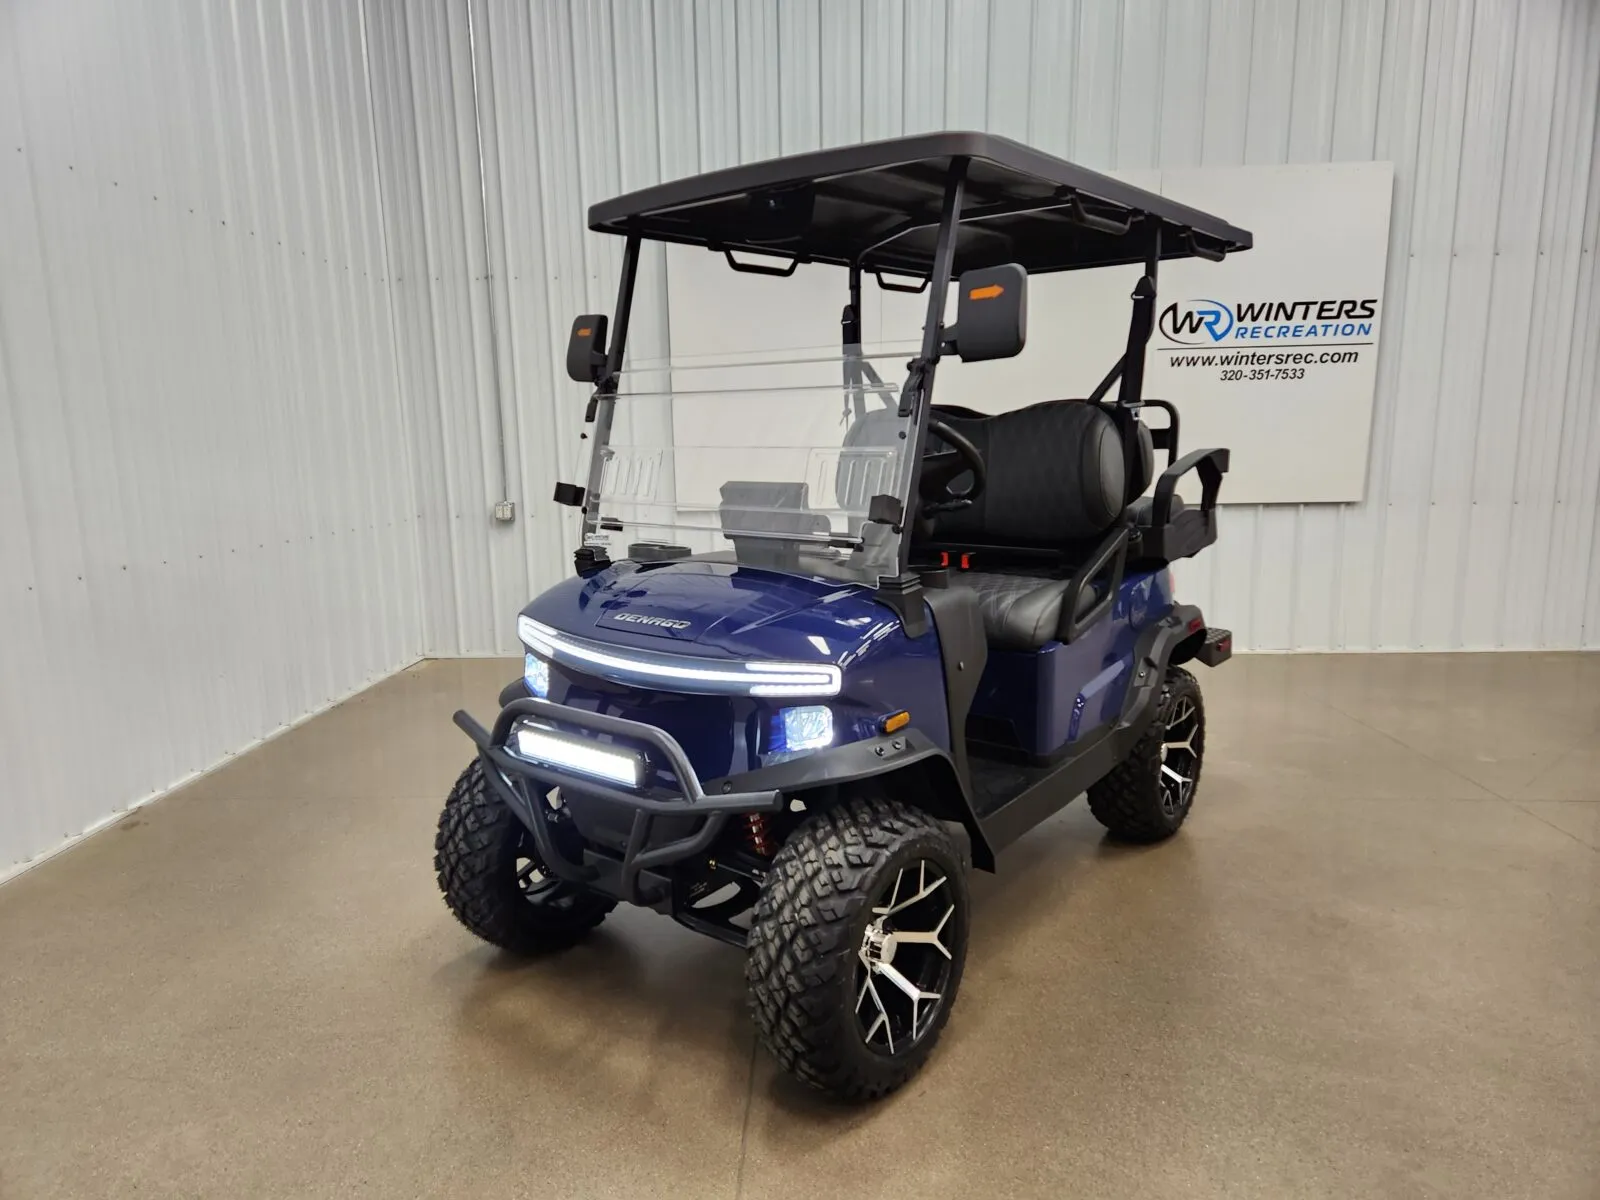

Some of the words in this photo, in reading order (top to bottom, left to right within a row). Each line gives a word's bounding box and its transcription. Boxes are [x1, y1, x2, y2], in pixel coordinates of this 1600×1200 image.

[1236, 299, 1378, 323] WINTERS
[1235, 323, 1373, 340] RECREATION
[1170, 350, 1359, 368] www.wintersrec.com
[1220, 368, 1305, 381] 320-351-7533
[613, 612, 692, 629] DENAGO
